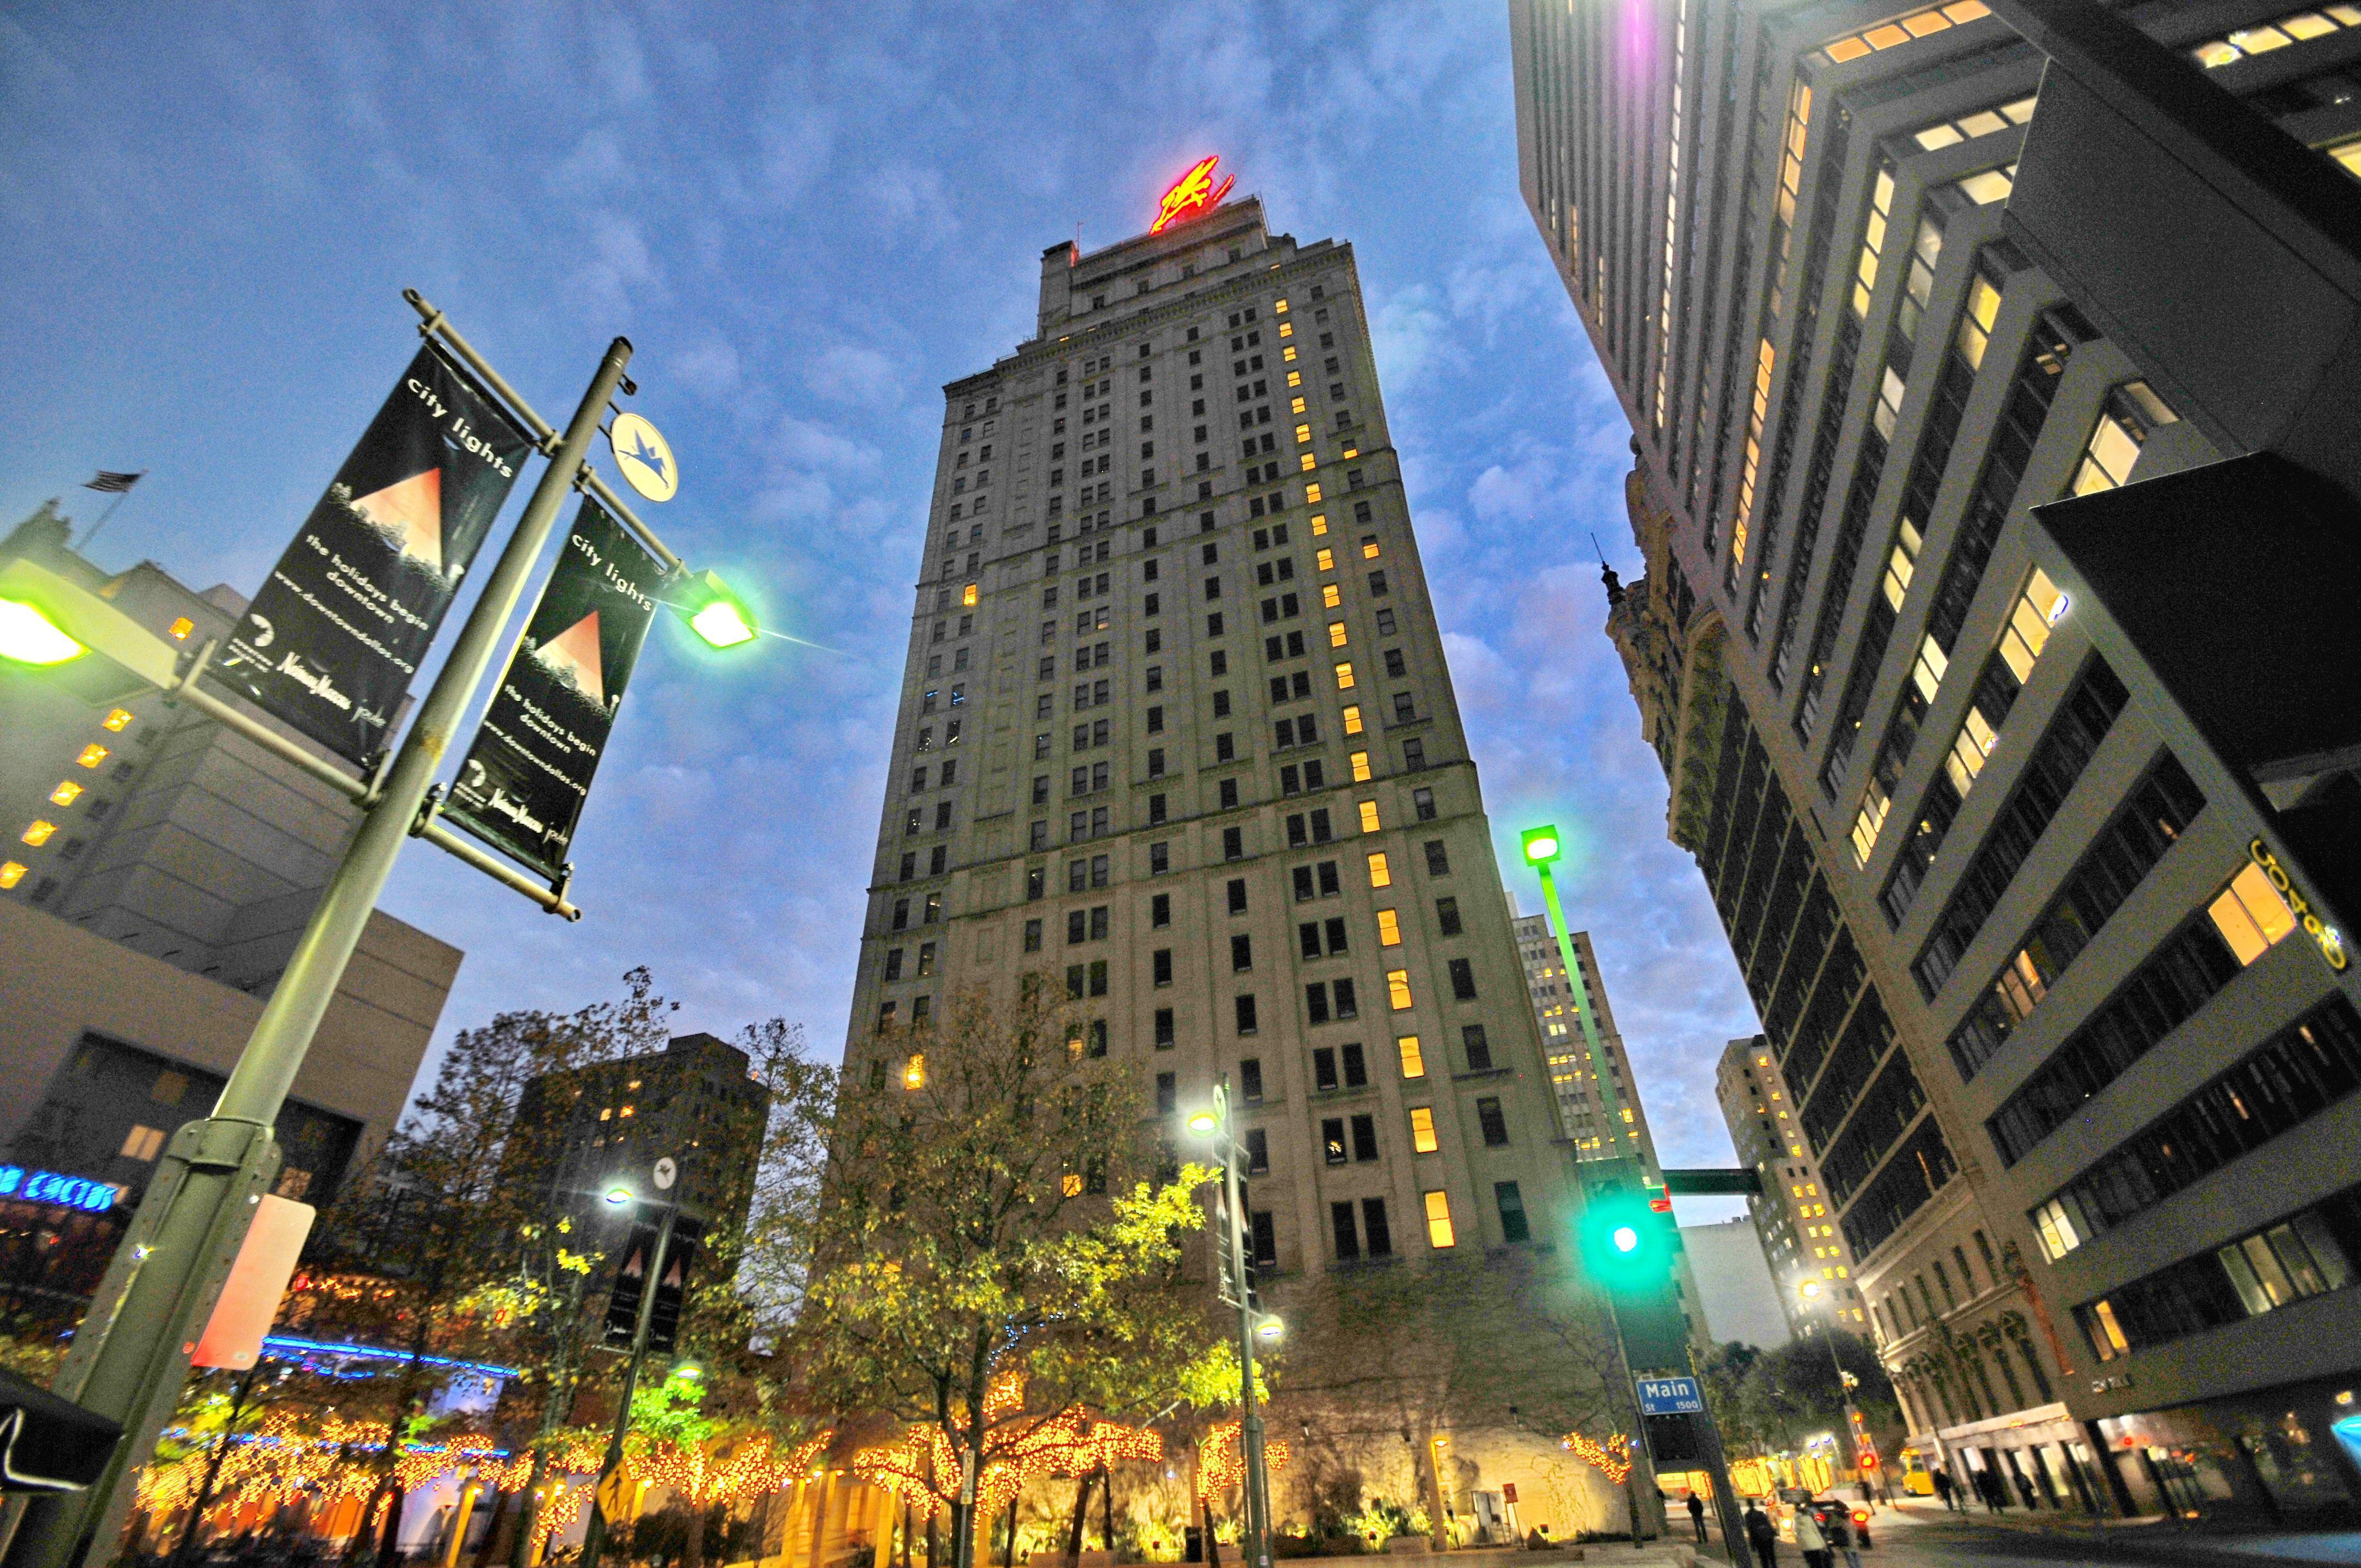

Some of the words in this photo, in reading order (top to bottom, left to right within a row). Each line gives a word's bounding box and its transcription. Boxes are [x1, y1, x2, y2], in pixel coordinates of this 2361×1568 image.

[408, 379, 448, 417] city
[452, 417, 513, 477] lights
[306, 534, 329, 556] the
[331, 554, 388, 602] holidays
[390, 600, 429, 631] begin
[326, 571, 395, 623] downtown
[572, 534, 602, 567] city
[606, 563, 651, 611] lights
[275, 571, 414, 674] www.downtowndallas.org
[505, 684, 522, 701] the
[523, 698, 565, 735] holidays
[567, 731, 596, 756] begin
[520, 714, 571, 753] downtown
[483, 720, 586, 796] www.downtowndallas.org
[1645, 1381, 1689, 1398] Main
[1645, 1403, 1656, 1412] St
[1676, 1401, 1698, 1409] 1500
